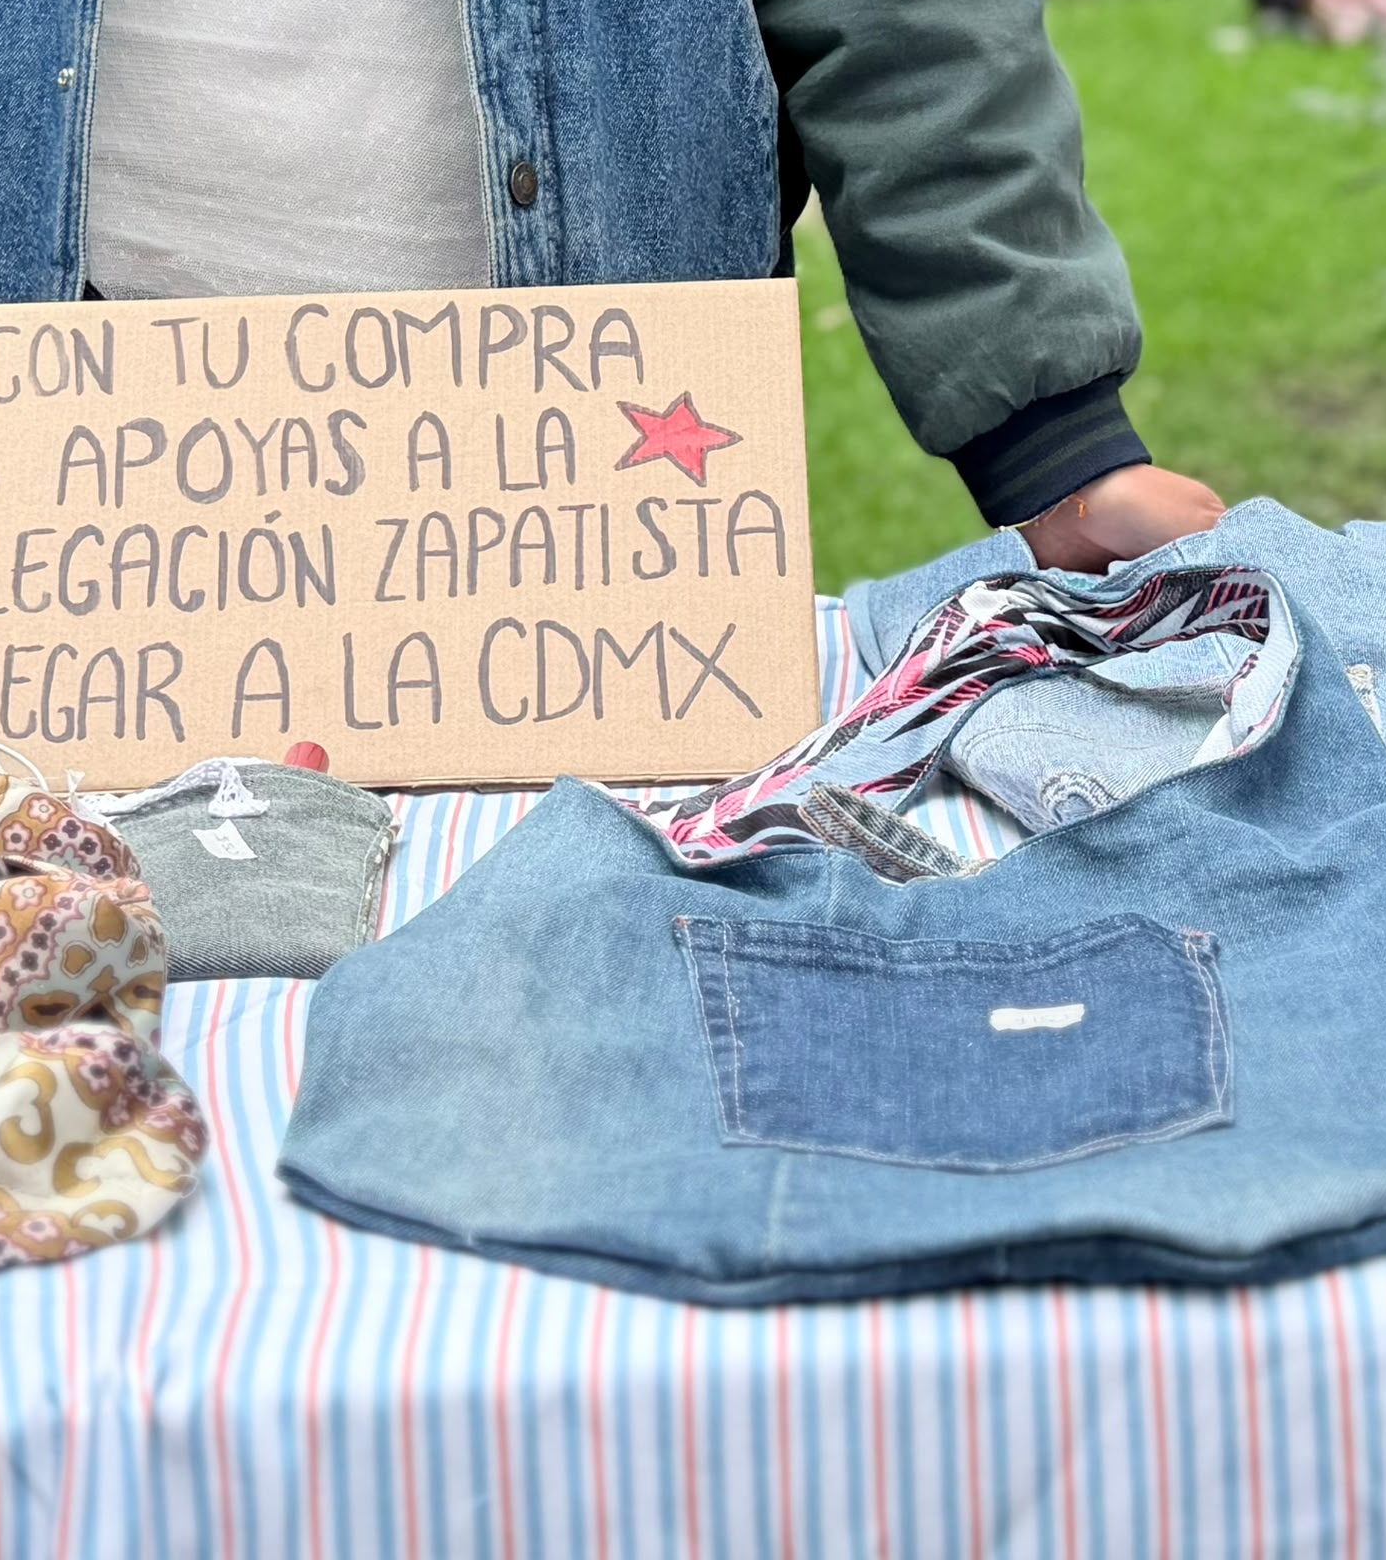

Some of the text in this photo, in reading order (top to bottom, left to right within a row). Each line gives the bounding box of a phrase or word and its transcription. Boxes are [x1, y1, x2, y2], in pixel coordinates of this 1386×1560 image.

[151, 317, 249, 389] TU
[284, 302, 643, 393] COMPRA
[57, 407, 575, 508] APOYAS A LA
[375, 490, 786, 602] ZAPATISTA
[232, 638, 290, 739] A
[343, 632, 442, 729] LA
[478, 617, 763, 725] CDMX
